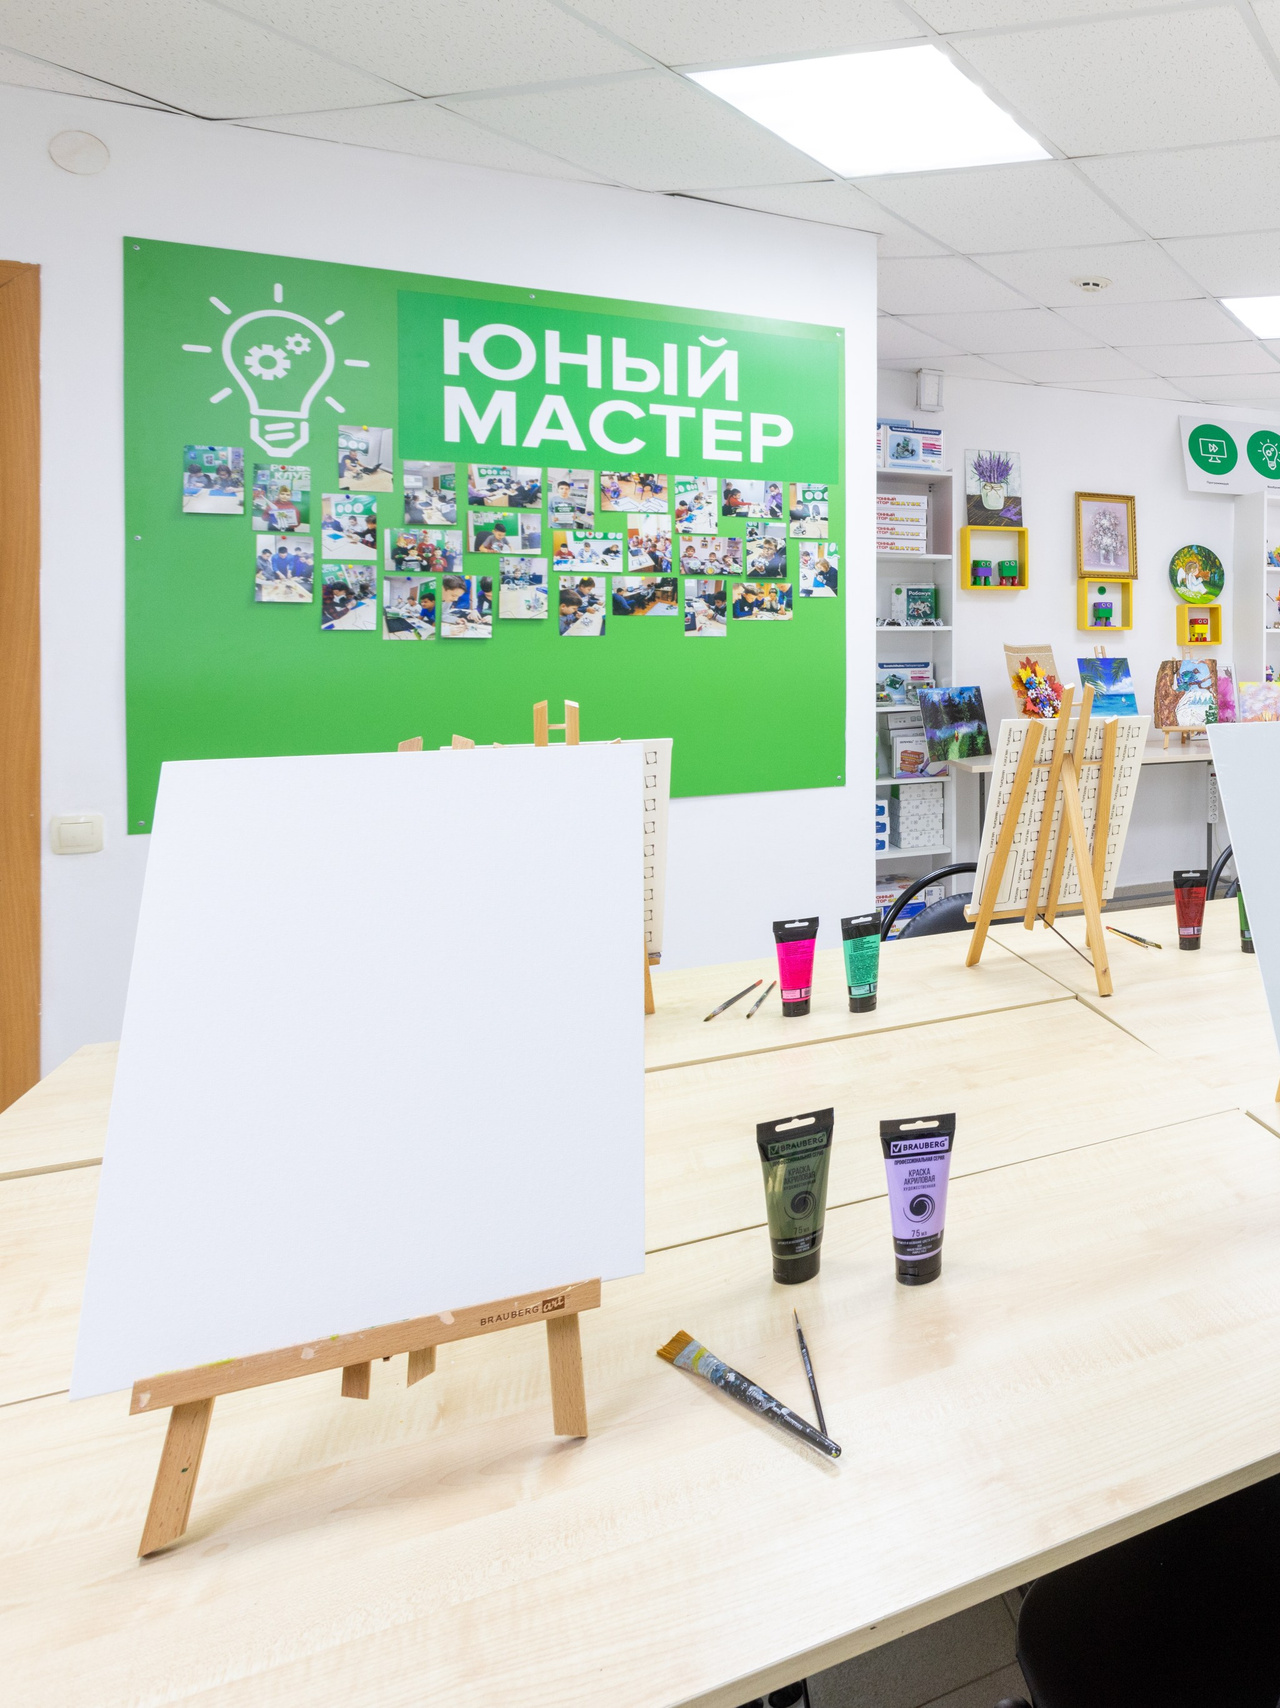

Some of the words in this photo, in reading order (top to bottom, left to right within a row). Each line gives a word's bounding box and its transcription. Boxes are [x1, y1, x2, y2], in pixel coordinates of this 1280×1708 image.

[443, 318, 739, 402] ЮНЫЙ
[443, 385, 794, 463] МАСТЕР
[780, 1136, 824, 1152] BRAUBERG
[902, 1140, 946, 1151] BRAUBERG
[788, 1164, 811, 1176] КРАСКА
[908, 1167, 931, 1177] КРАСКА
[903, 1174, 936, 1186] АКРИЛОВАЯ
[793, 1226, 803, 1236] 75
[911, 1229, 921, 1238] 75
[480, 1305, 539, 1326] BRAUBERG
[543, 1296, 565, 1313] art
